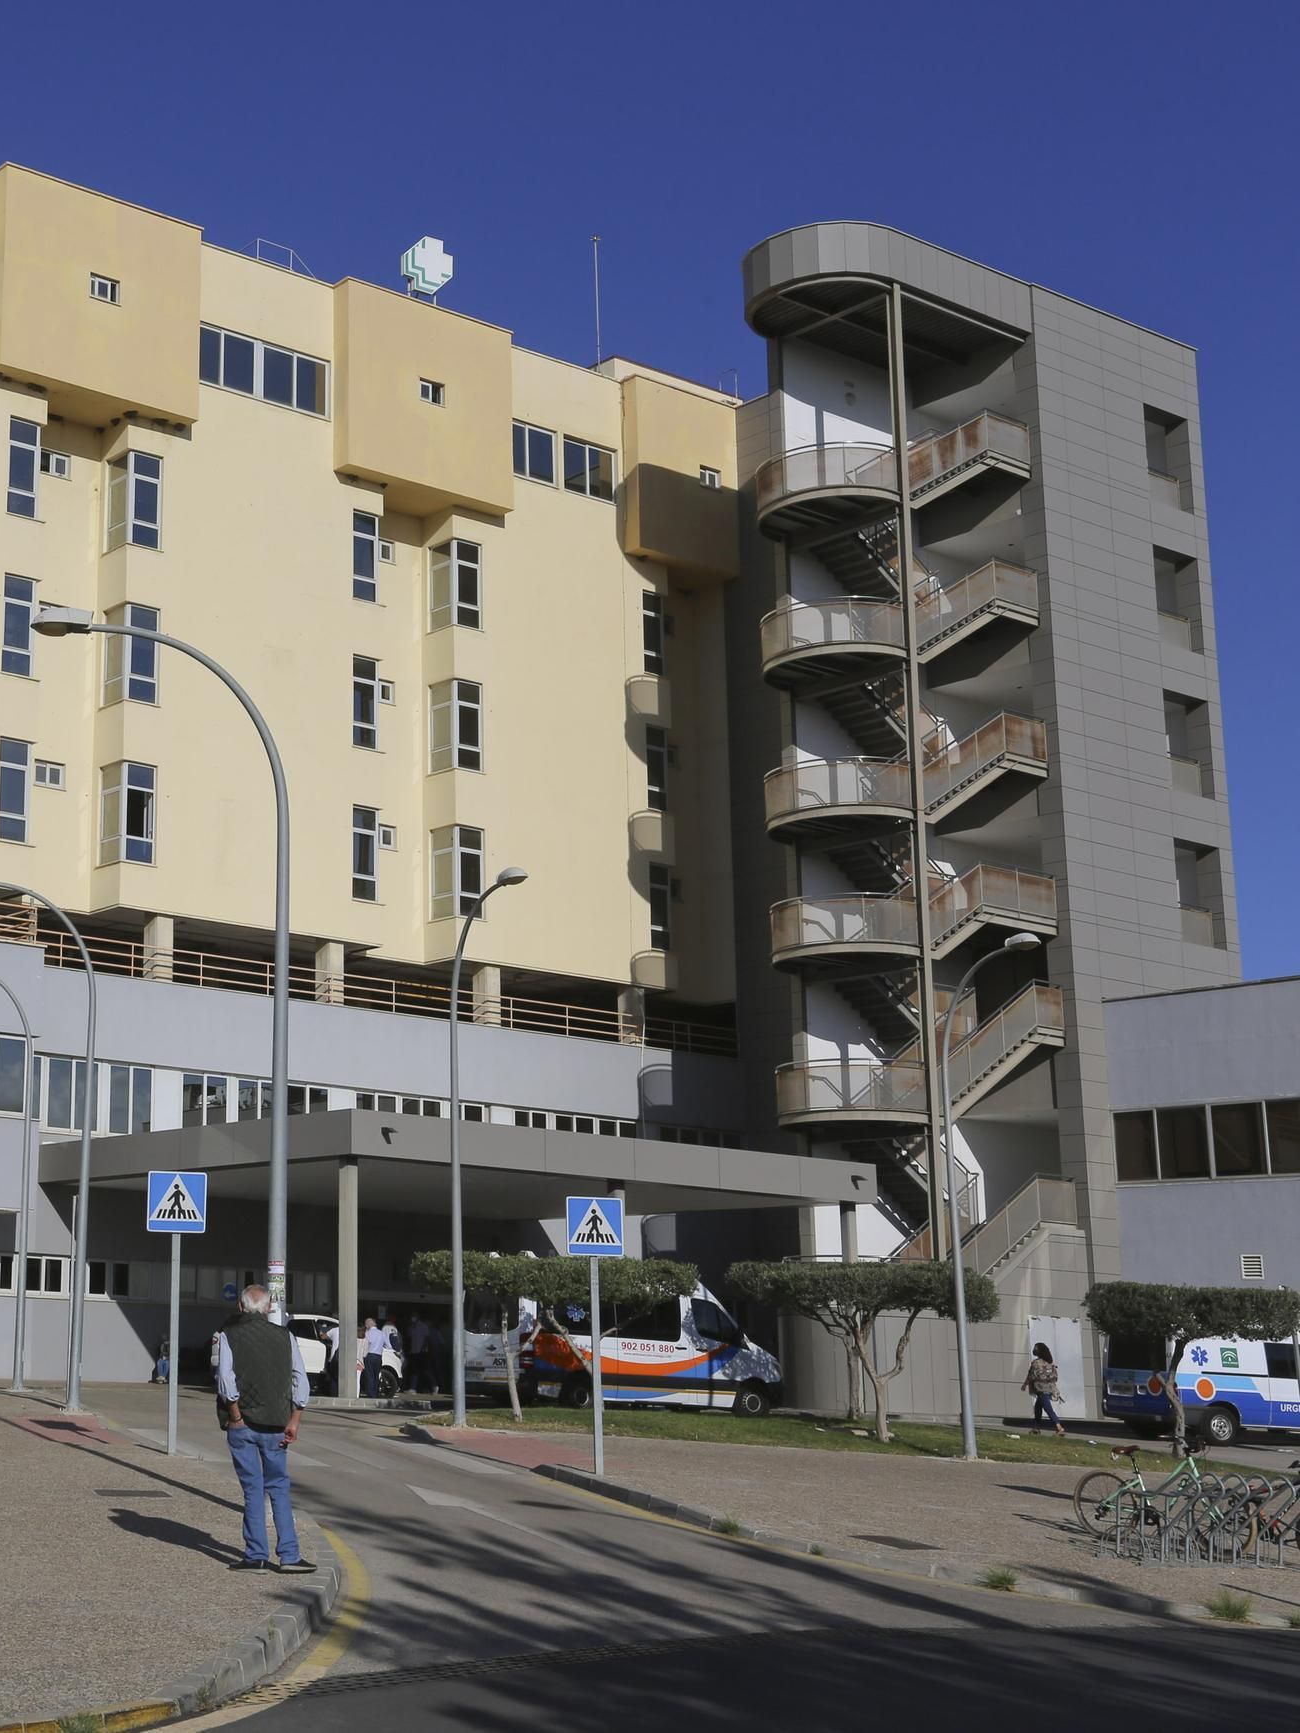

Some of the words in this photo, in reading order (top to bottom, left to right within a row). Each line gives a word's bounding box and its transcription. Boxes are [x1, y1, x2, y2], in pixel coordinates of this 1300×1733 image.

[621, 1341, 638, 1351] 902
[640, 1343, 656, 1353] 051
[658, 1344, 675, 1354] 880
[1280, 1403, 1300, 1413] URG
